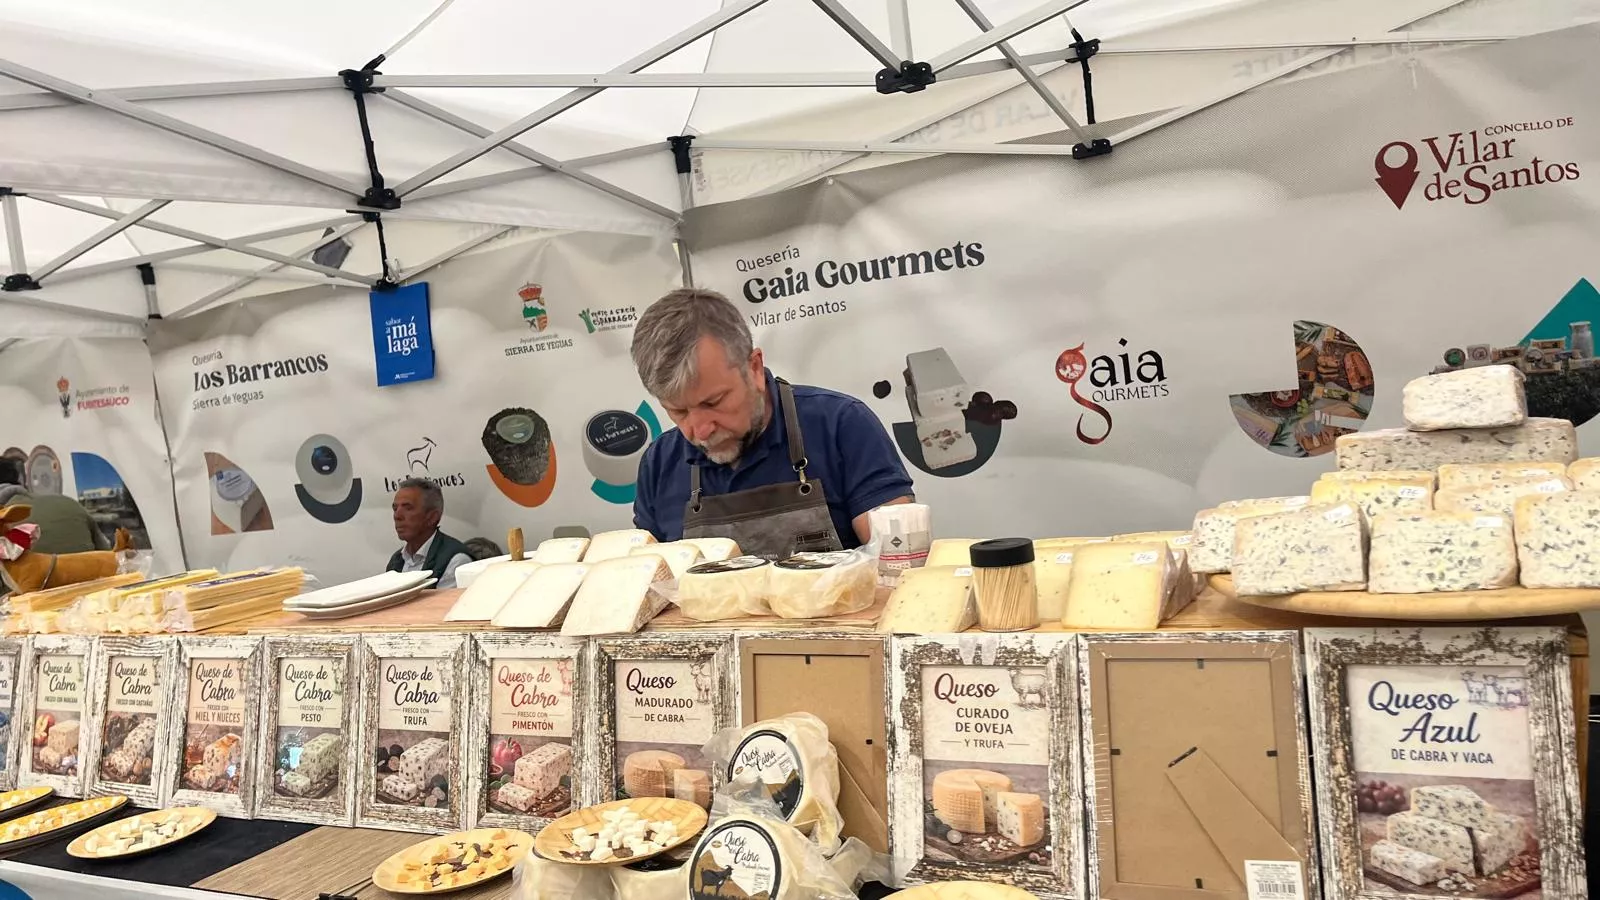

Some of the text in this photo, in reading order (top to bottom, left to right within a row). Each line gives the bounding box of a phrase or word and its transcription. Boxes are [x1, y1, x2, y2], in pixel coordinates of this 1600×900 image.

[1484, 117, 1574, 136] CONCELLO DE
[1421, 130, 1516, 173] Vilar
[736, 245, 800, 272] Quesería
[743, 240, 985, 304] Gaia Gourmets
[751, 299, 847, 327] Vilar de Santos
[392, 316, 417, 339] má
[387, 335, 419, 356] laga
[504, 338, 573, 357] SIERRA DE YEGUAS
[226, 353, 329, 385] Barrancos
[192, 390, 264, 410] Sierra de Yeguas
[43, 660, 73, 676] Queso de
[115, 661, 148, 679] Queso de
[196, 662, 233, 682] Queso de
[285, 663, 328, 684] Queso de
[386, 664, 433, 685] Queso de
[498, 665, 552, 686] Queso de
[49, 674, 77, 692] Cabra
[122, 676, 152, 695] Cabra
[626, 667, 677, 692] Queso
[934, 673, 1000, 704] Queso
[201, 679, 236, 702] Cabra
[294, 680, 333, 702] Cabra
[394, 681, 440, 706] Cabra
[510, 683, 559, 709] Cabra
[1368, 680, 1459, 717] Queso
[634, 697, 694, 709] MADURADO
[195, 711, 241, 723] MIEL Y NUECES
[301, 713, 322, 723] PESTO
[404, 716, 428, 726] TRUFA
[536, 711, 548, 719] CON
[644, 713, 685, 723] DE CABRA
[956, 707, 1009, 720] CURADO
[512, 719, 554, 731] PIMENTÓN
[955, 722, 1014, 735] DE OVEJA
[1398, 712, 1481, 744] Azul
[964, 739, 1005, 749] Y TRUFA
[757, 750, 776, 771] Cabra
[1391, 748, 1494, 765] DE CABRA Y VACA
[734, 847, 759, 864] Cabra
